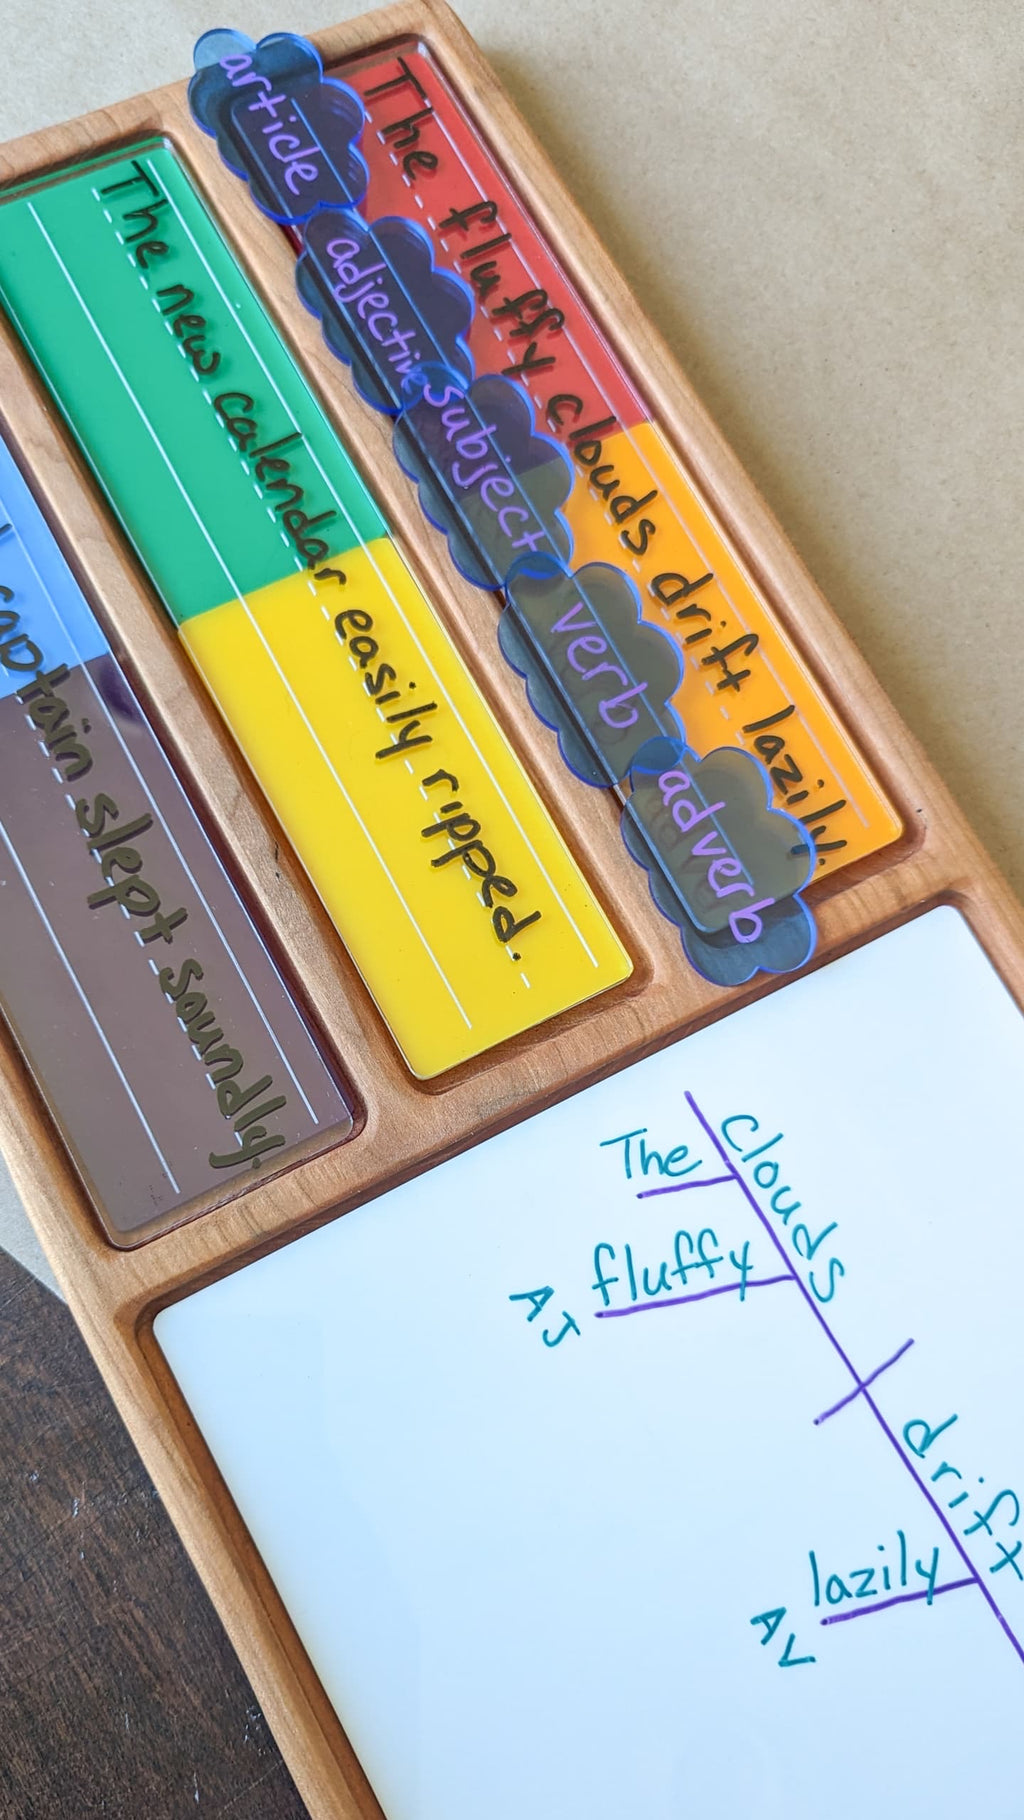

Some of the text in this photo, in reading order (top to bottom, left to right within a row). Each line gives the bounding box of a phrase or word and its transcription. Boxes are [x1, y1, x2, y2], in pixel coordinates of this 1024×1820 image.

[219, 53, 318, 195] article
[326, 238, 428, 395] adjective
[364, 57, 848, 866] The fluffy clouds drift lazily.
[423, 383, 547, 553] subject
[100, 160, 542, 962] The new calendar easily ripped.
[551, 602, 648, 729] verb
[658, 770, 775, 943] adverb
[76, 793, 188, 944] slept
[159, 959, 286, 1169] soundly.
[599, 1127, 703, 1179] The
[509, 1286, 580, 1347] AJ
[592, 1228, 754, 1305] fluffy
[809, 1530, 939, 1606] lazily
[903, 1414, 1023, 1581] drift
